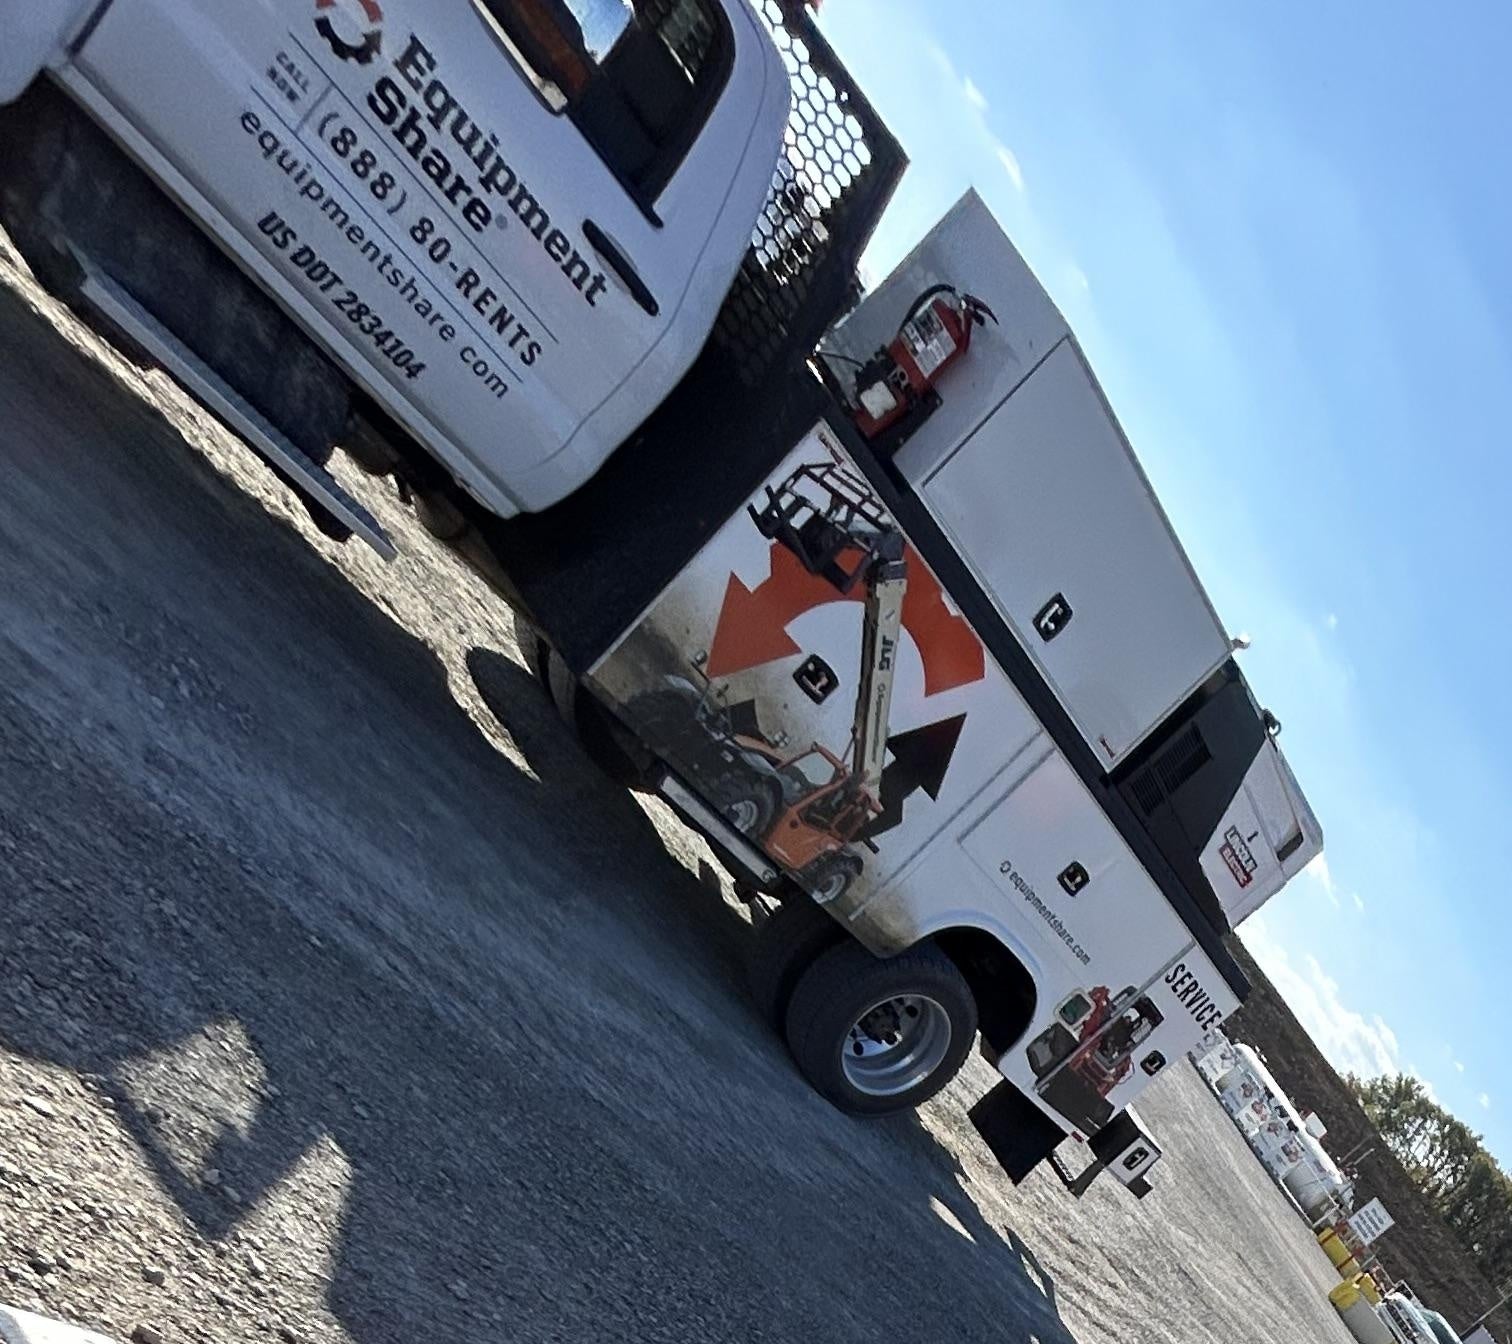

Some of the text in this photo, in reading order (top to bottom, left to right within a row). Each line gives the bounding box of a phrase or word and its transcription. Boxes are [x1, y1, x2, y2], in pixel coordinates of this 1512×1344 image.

[365, 76, 494, 233] Share
[391, 33, 609, 308] Equipment
[238, 109, 511, 400] equipmentsharecom
[256, 211, 295, 250] US
[287, 245, 341, 295] DOT
[315, 110, 544, 367] (888) 80-RENTS
[1226, 829, 1255, 872] LINCOLN
[1009, 871, 1092, 966] equipmentshare.com
[1164, 963, 1222, 1032] SERVICE
